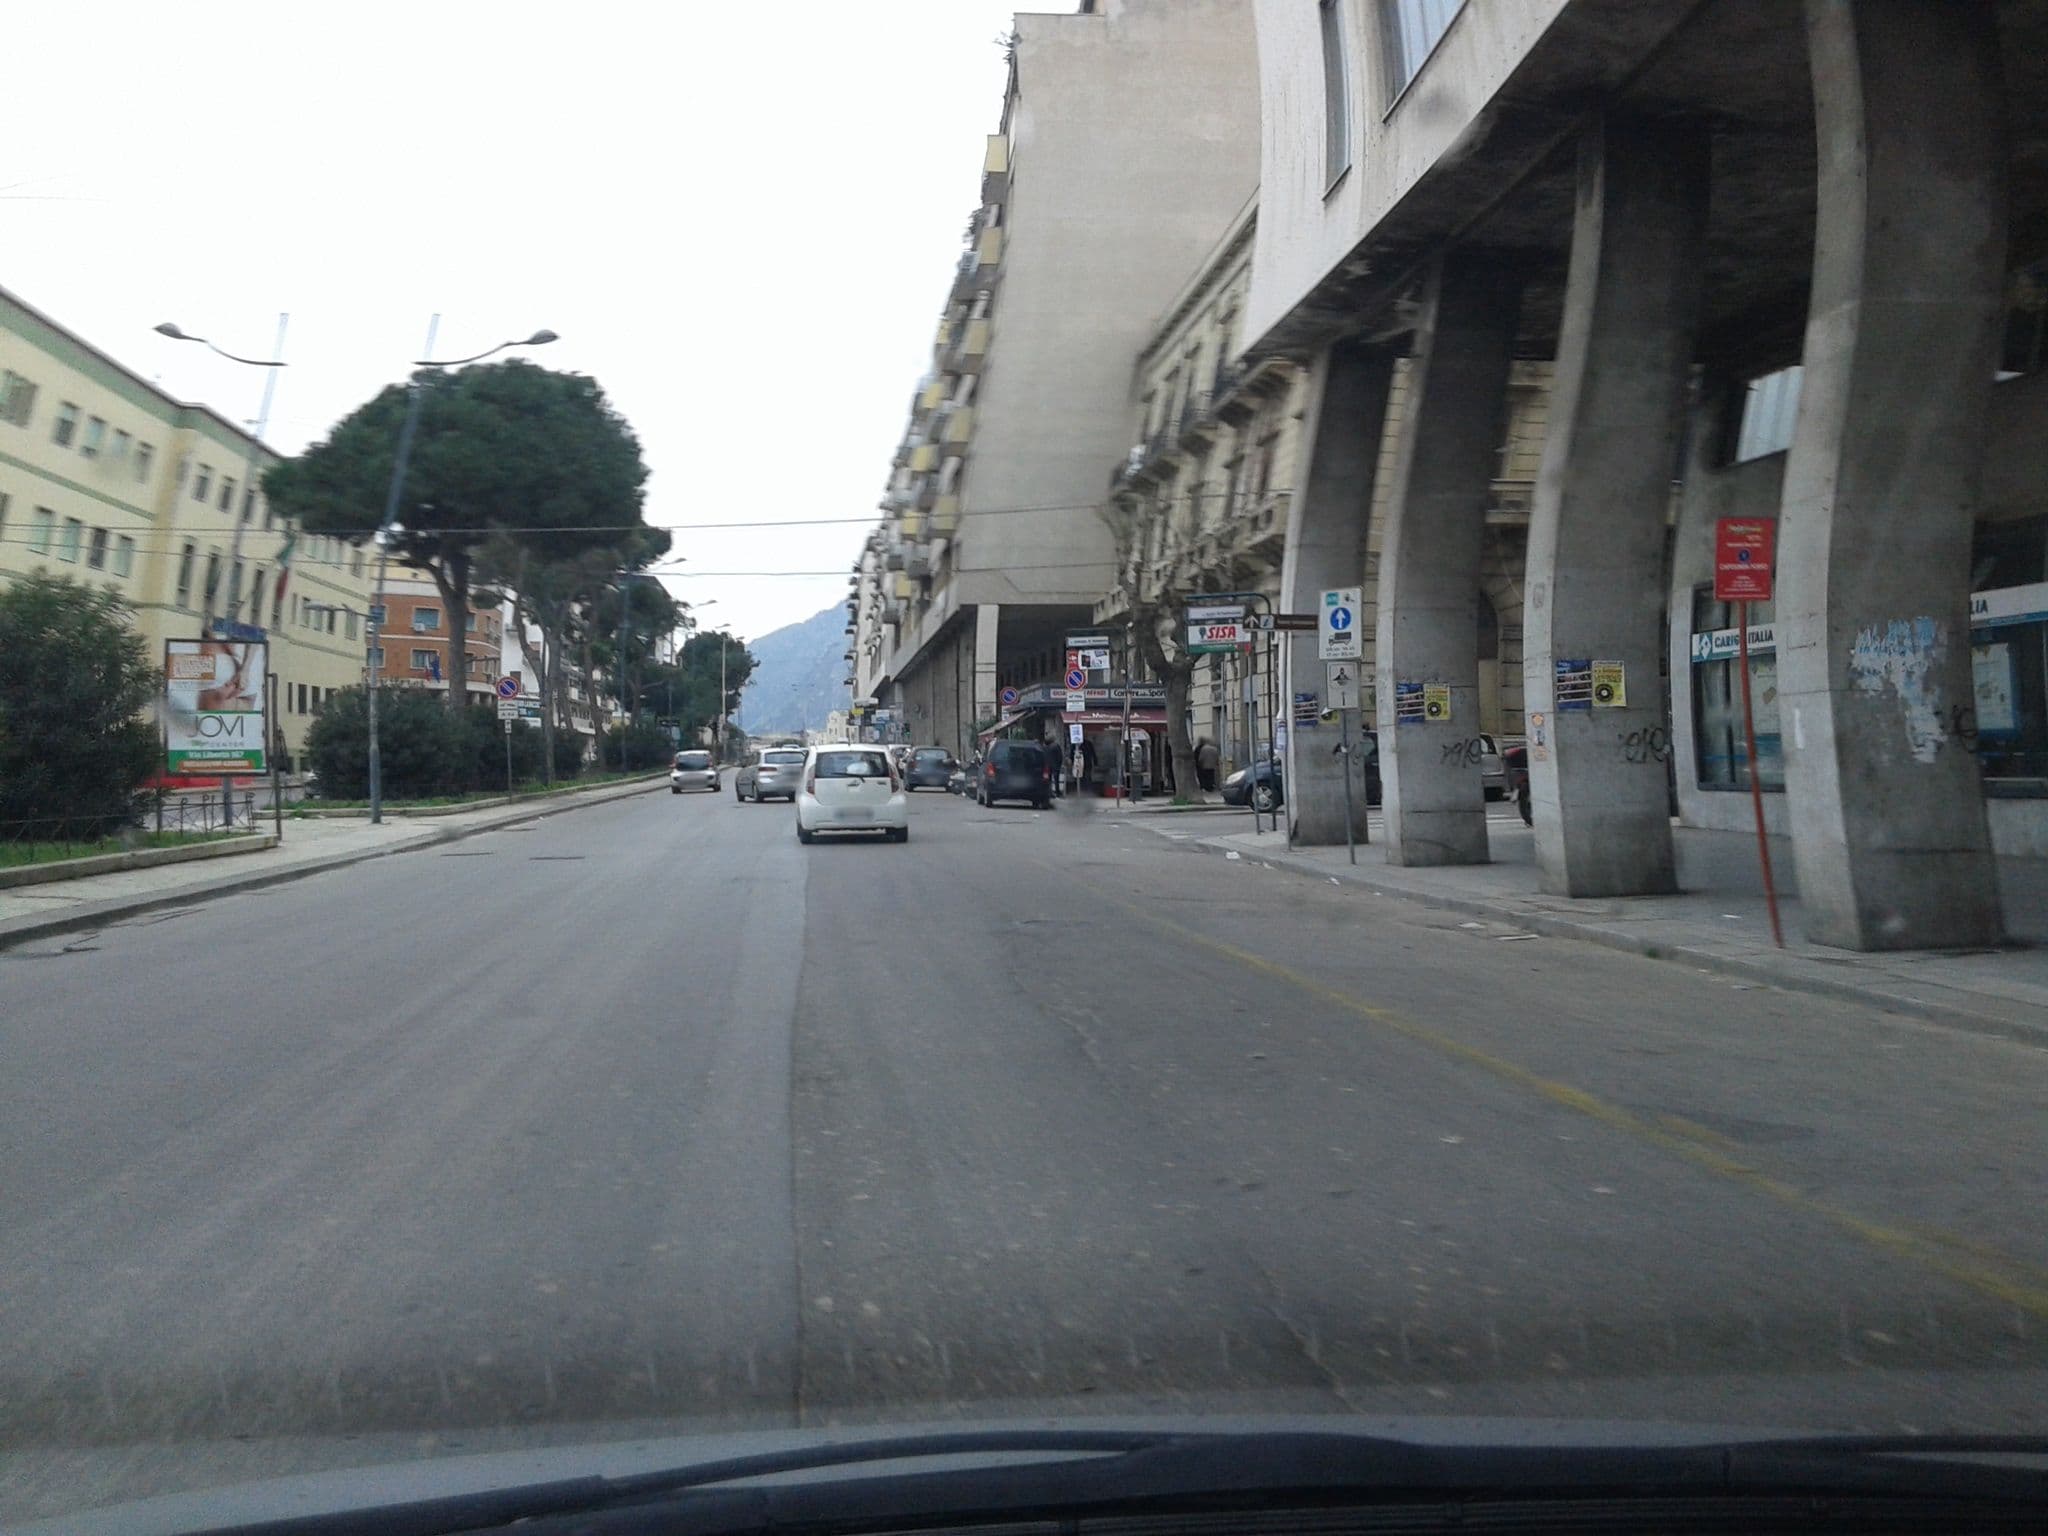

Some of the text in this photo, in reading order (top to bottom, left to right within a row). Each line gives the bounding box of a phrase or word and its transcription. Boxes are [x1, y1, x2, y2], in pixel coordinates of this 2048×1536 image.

[1207, 625, 1237, 639] SISA
[1714, 629, 1774, 648] CARIG ITALIA
